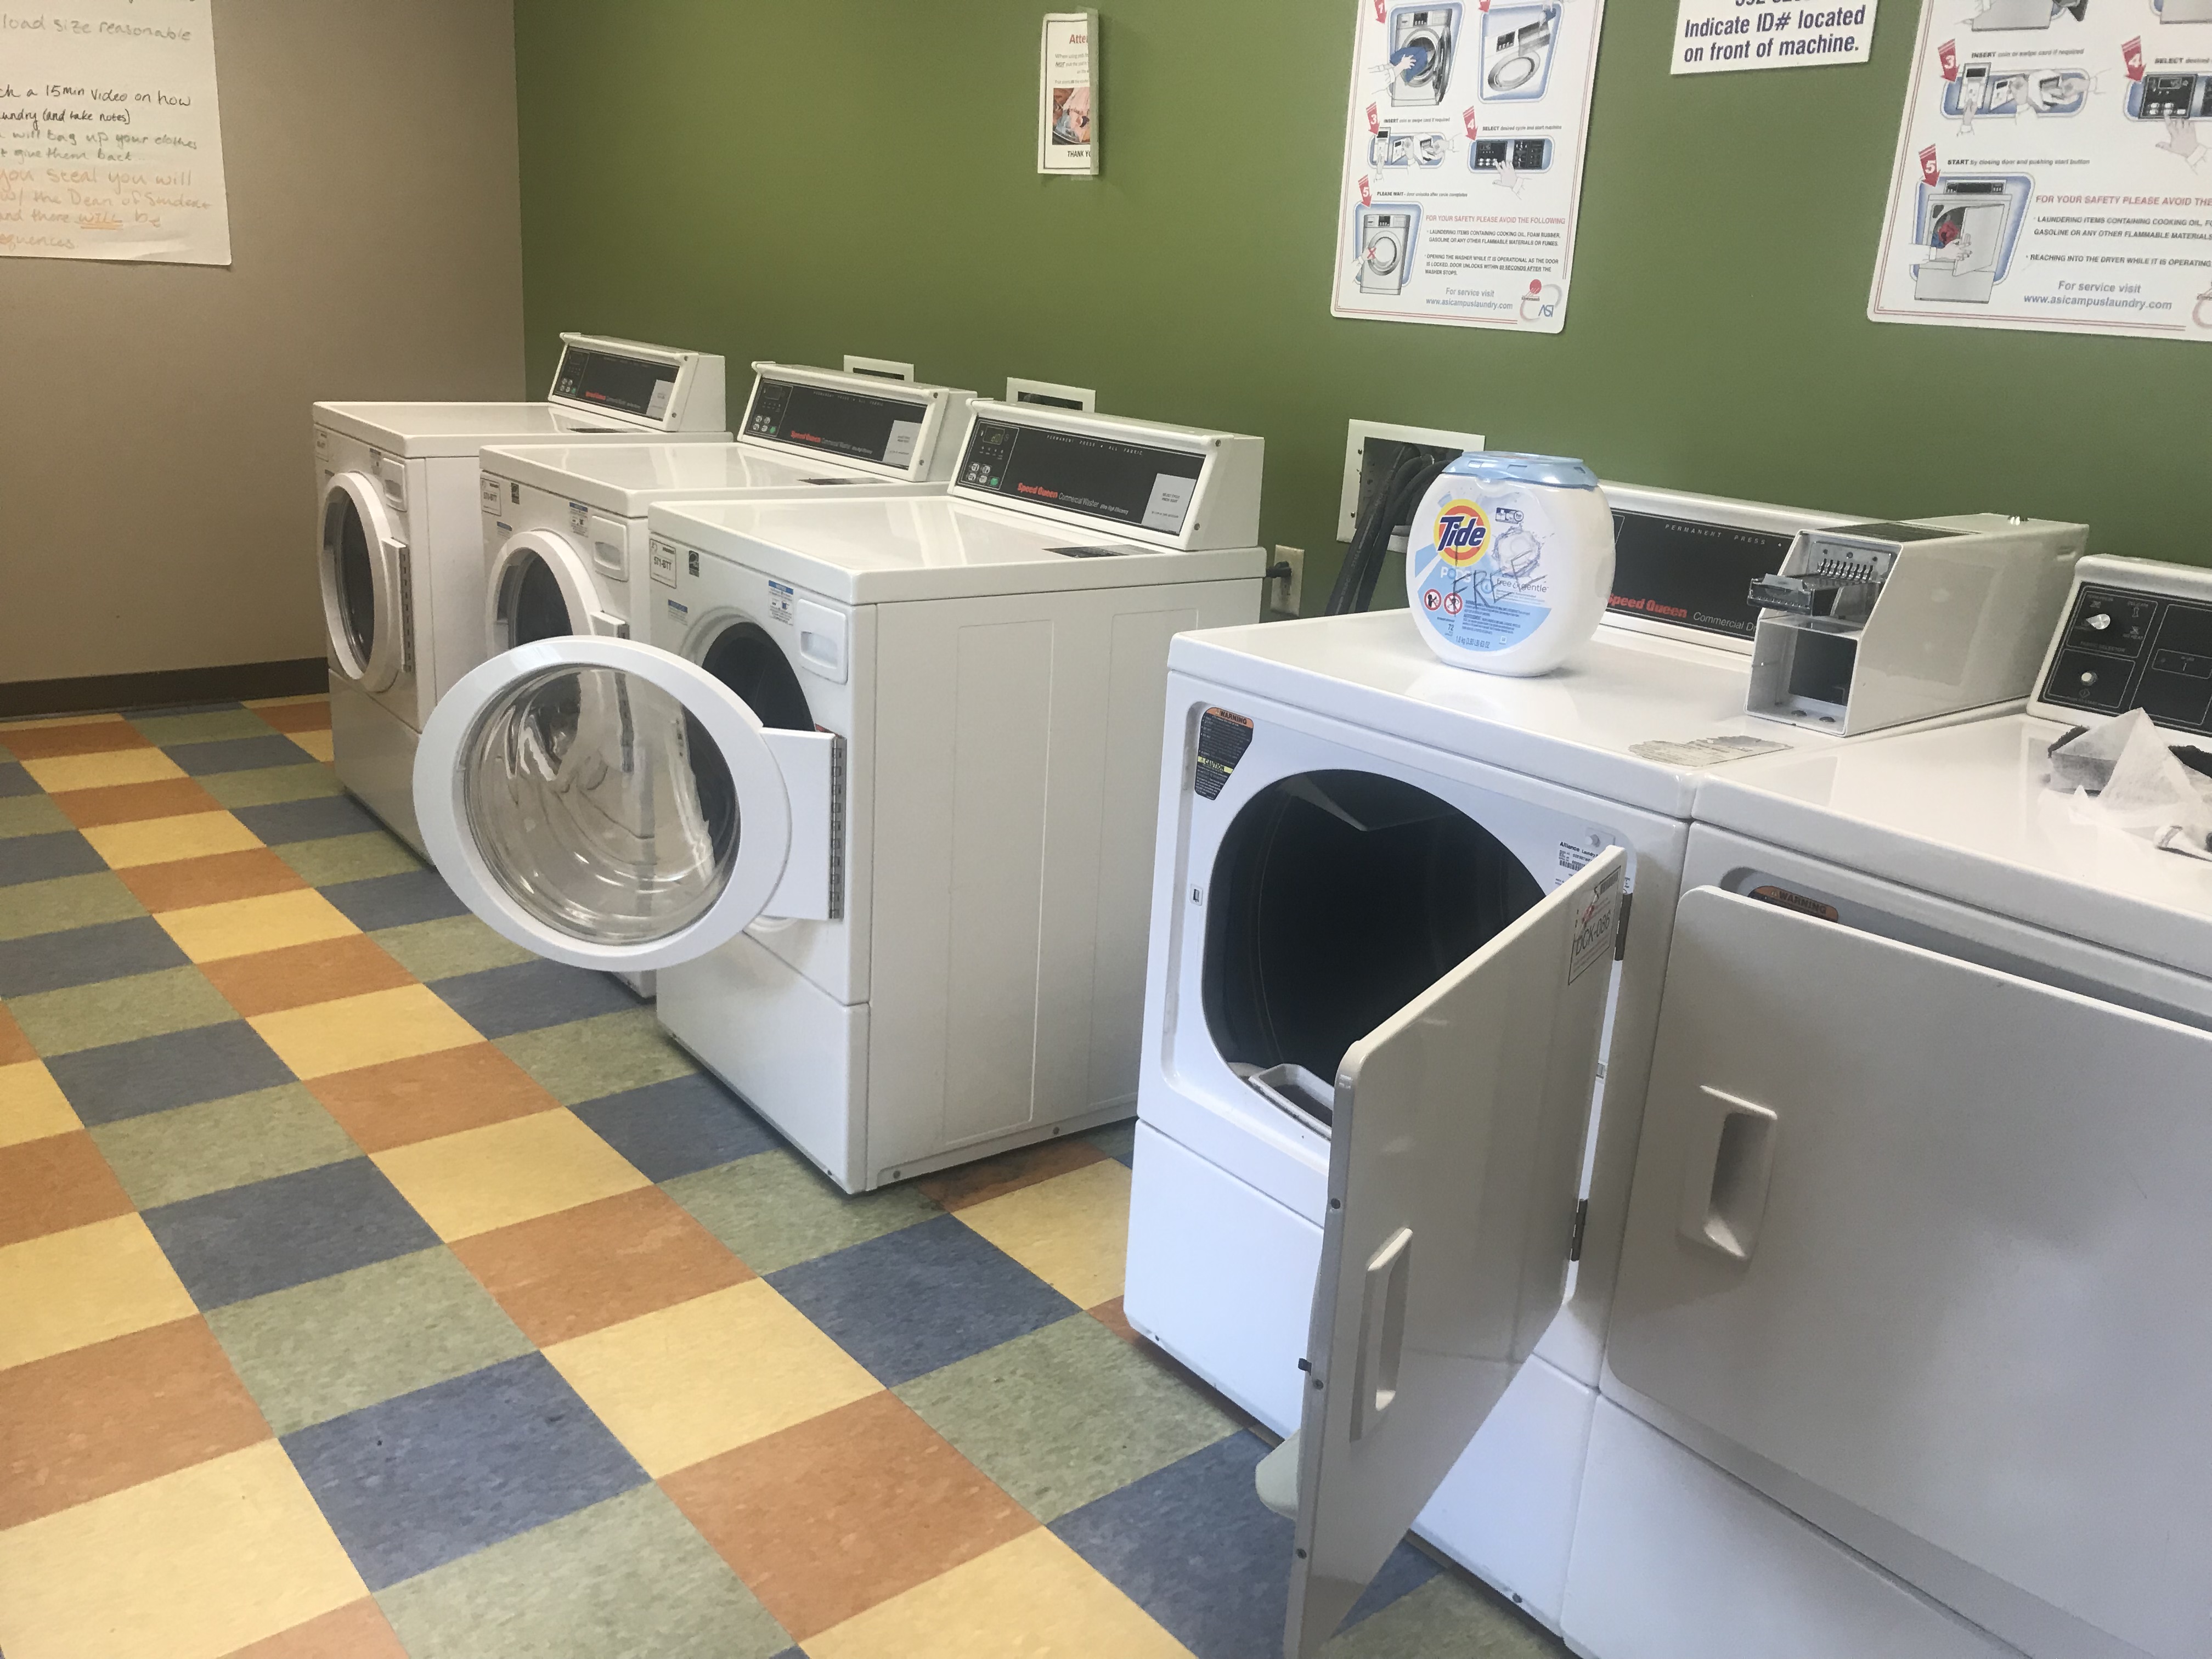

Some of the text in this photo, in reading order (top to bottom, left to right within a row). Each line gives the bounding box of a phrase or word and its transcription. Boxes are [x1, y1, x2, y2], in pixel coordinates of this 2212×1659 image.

[1378, 3, 1384, 13] 1
[3, 14, 191, 40] load size reasonable
[1684, 4, 1867, 38] Indicate ID# located
[1069, 34, 1088, 44] Atte
[1684, 33, 1859, 63] on front of machine.
[1944, 55, 1954, 69] 3
[2128, 53, 2142, 68] 4
[26, 89, 38, 97] a
[134, 92, 151, 102] on
[158, 91, 191, 106] how
[0, 108, 39, 131] undry
[70, 110, 93, 121] take
[99, 109, 130, 125] notes)
[1370, 114, 1377, 125] 3
[1468, 119, 1474, 129] 4
[13, 129, 40, 139] will
[86, 131, 109, 147] up
[116, 134, 149, 150] your
[155, 134, 198, 150] clothes
[14, 149, 43, 165] give
[46, 147, 89, 159] them
[1925, 160, 1936, 174] 5
[0, 167, 191, 195] you steal you will
[33, 190, 61, 204] the
[67, 188, 114, 207] Dean
[122, 190, 142, 205] of
[1362, 187, 1369, 198] 5
[2036, 195, 2212, 206] FOR YOUR SAFETY PLEASE AVOID THE
[31, 208, 161, 227] there be
[2171, 233, 2212, 241] MATERIALS
[2169, 259, 2212, 267] OPERATING
[1458, 289, 1480, 297] service
[2058, 280, 2141, 294] For service visit
[1426, 298, 1513, 310] www.asicampuslaundry.com
[2024, 295, 2172, 311] www.asicampuslaundry.com
[1018, 482, 1099, 507] Speed Queen Commercial Washer
[1437, 516, 1486, 551] Tide
[1665, 524, 1765, 545] PERMANENT PRESS
[1451, 538, 1548, 617] FREE
[1497, 578, 1512, 587] free
[1609, 592, 1646, 609] Speed
[1646, 599, 1688, 619] Queen
[1693, 612, 1745, 629] Commercial
[1220, 710, 1248, 725] WARNING
[1205, 758, 1225, 771] CAUTION
[1560, 842, 1580, 852] Alliance
[1779, 891, 1827, 914] WARNING
